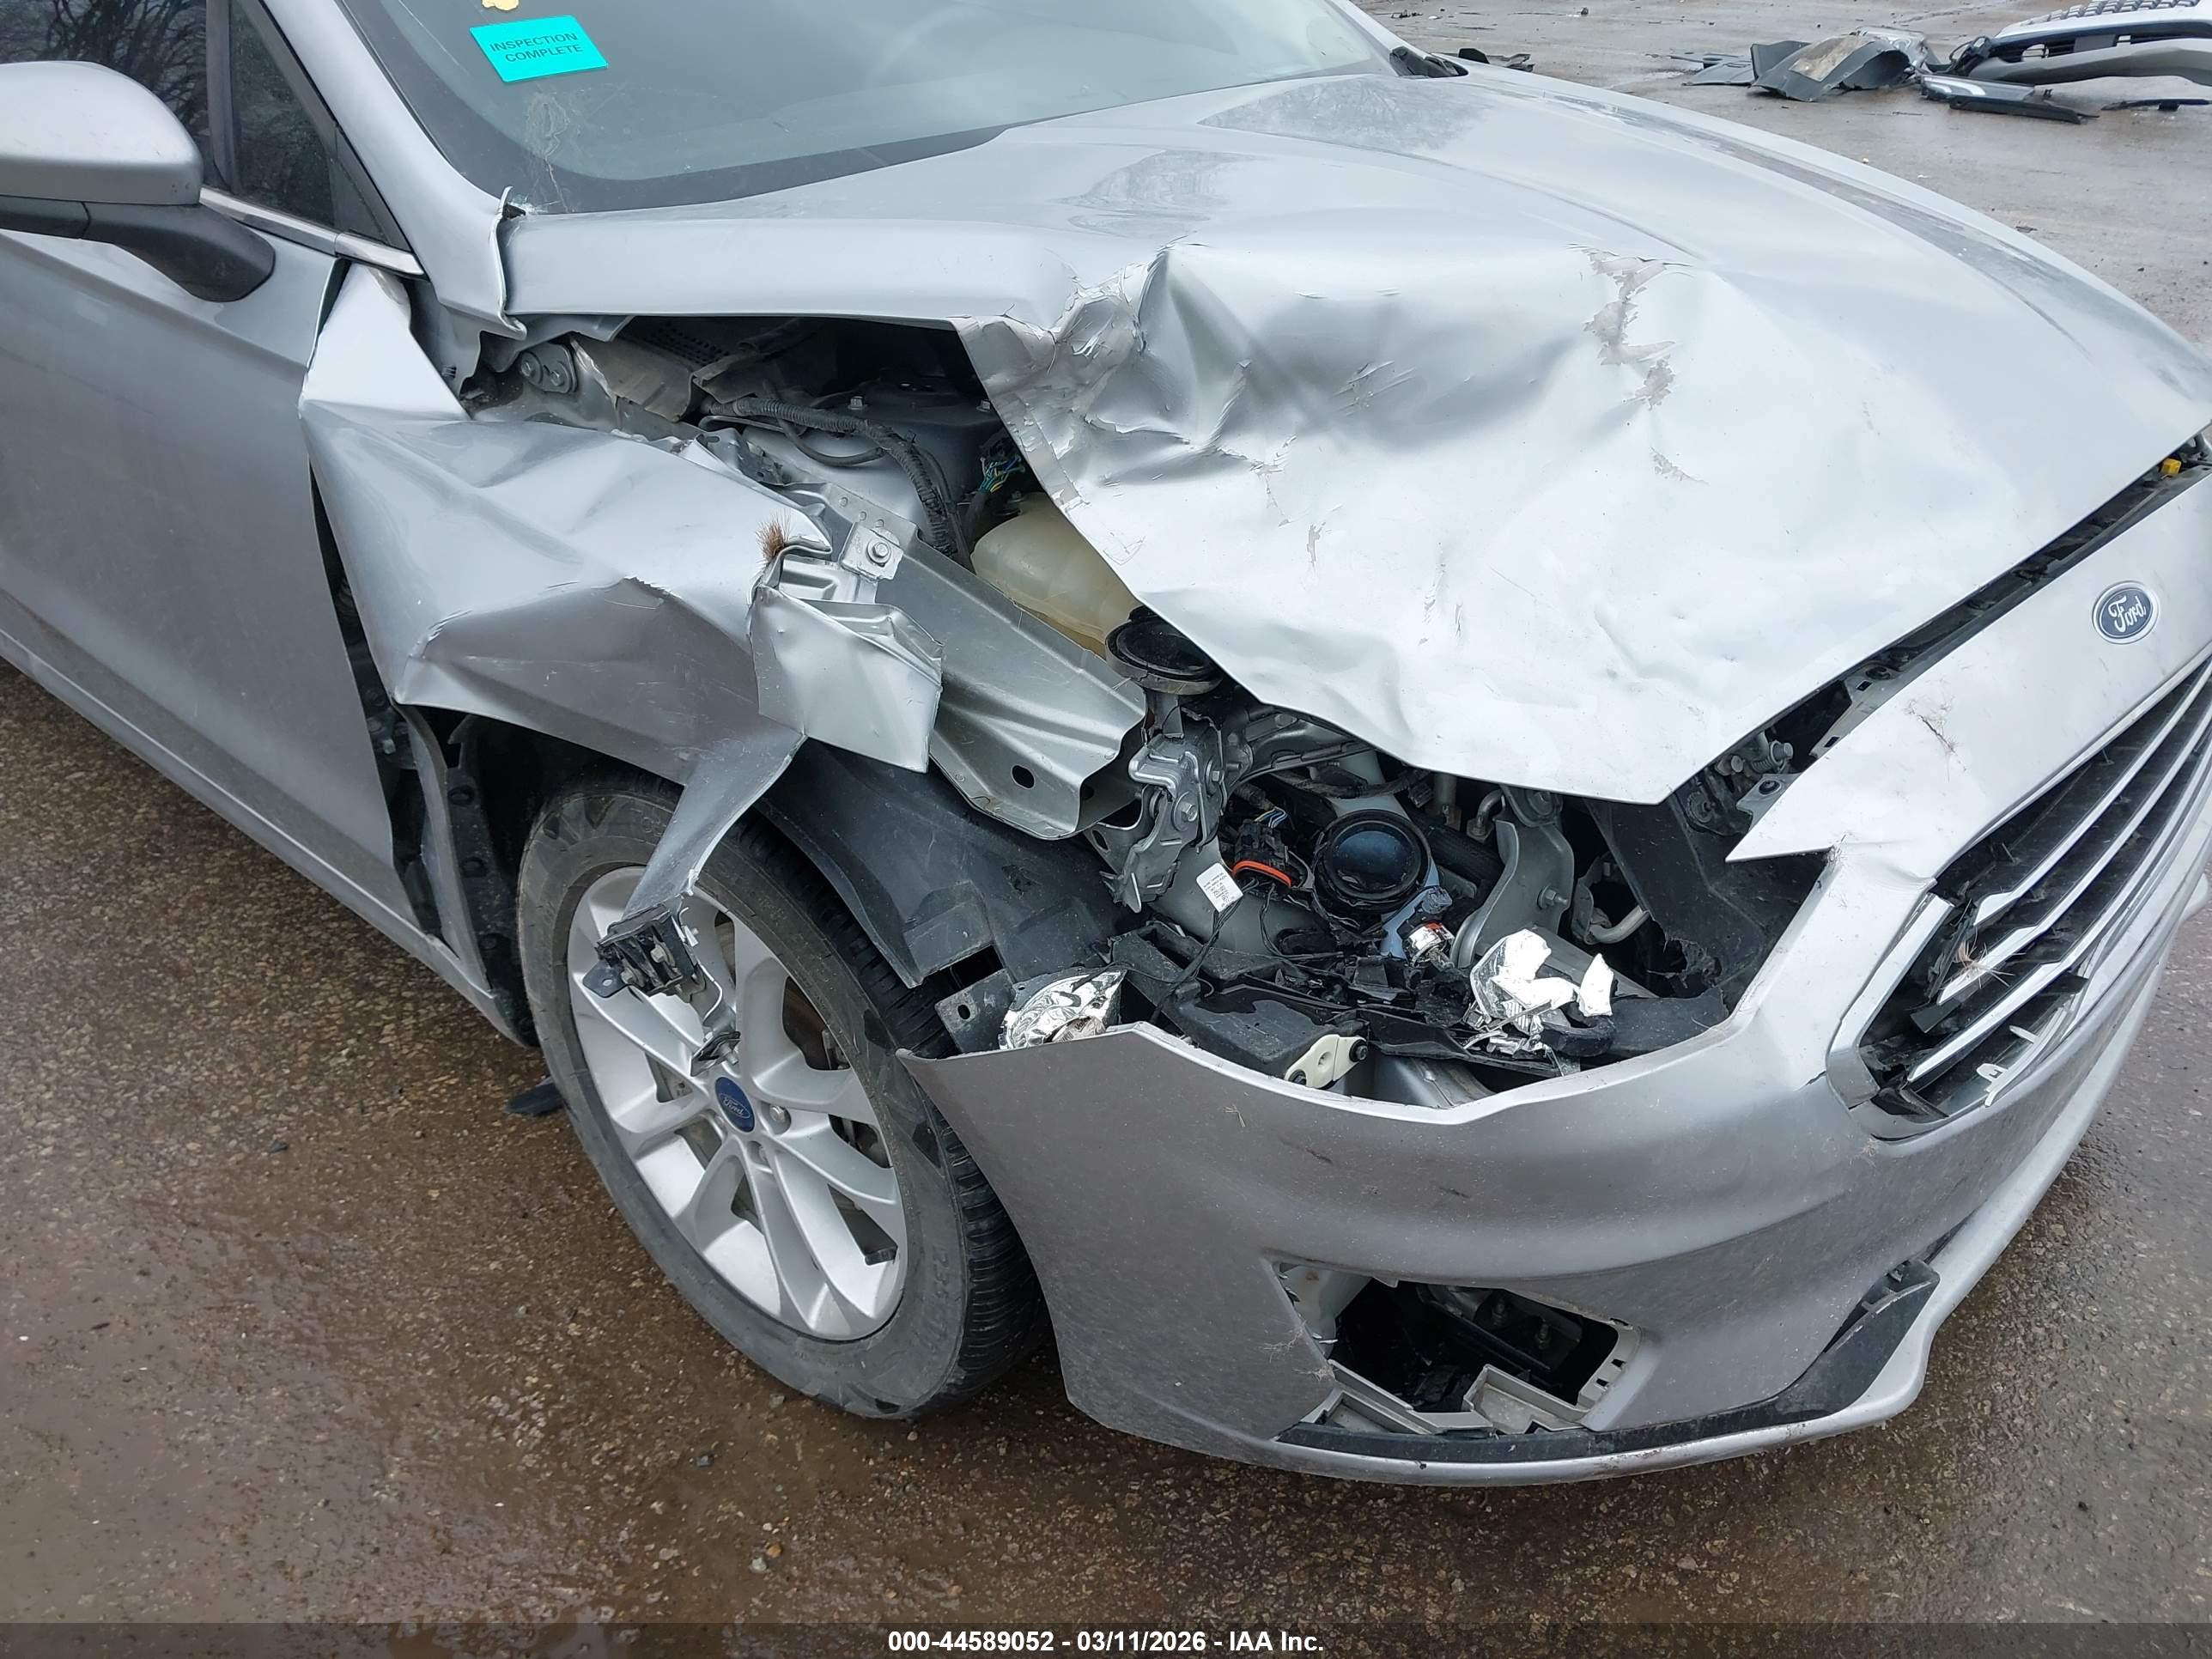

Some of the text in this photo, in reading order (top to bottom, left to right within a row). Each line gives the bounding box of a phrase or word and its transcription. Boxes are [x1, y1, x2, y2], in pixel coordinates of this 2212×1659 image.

[489, 32, 579, 52] INSPECTION
[504, 43, 584, 63] COMPLETE
[2107, 594, 2147, 633] Ford
